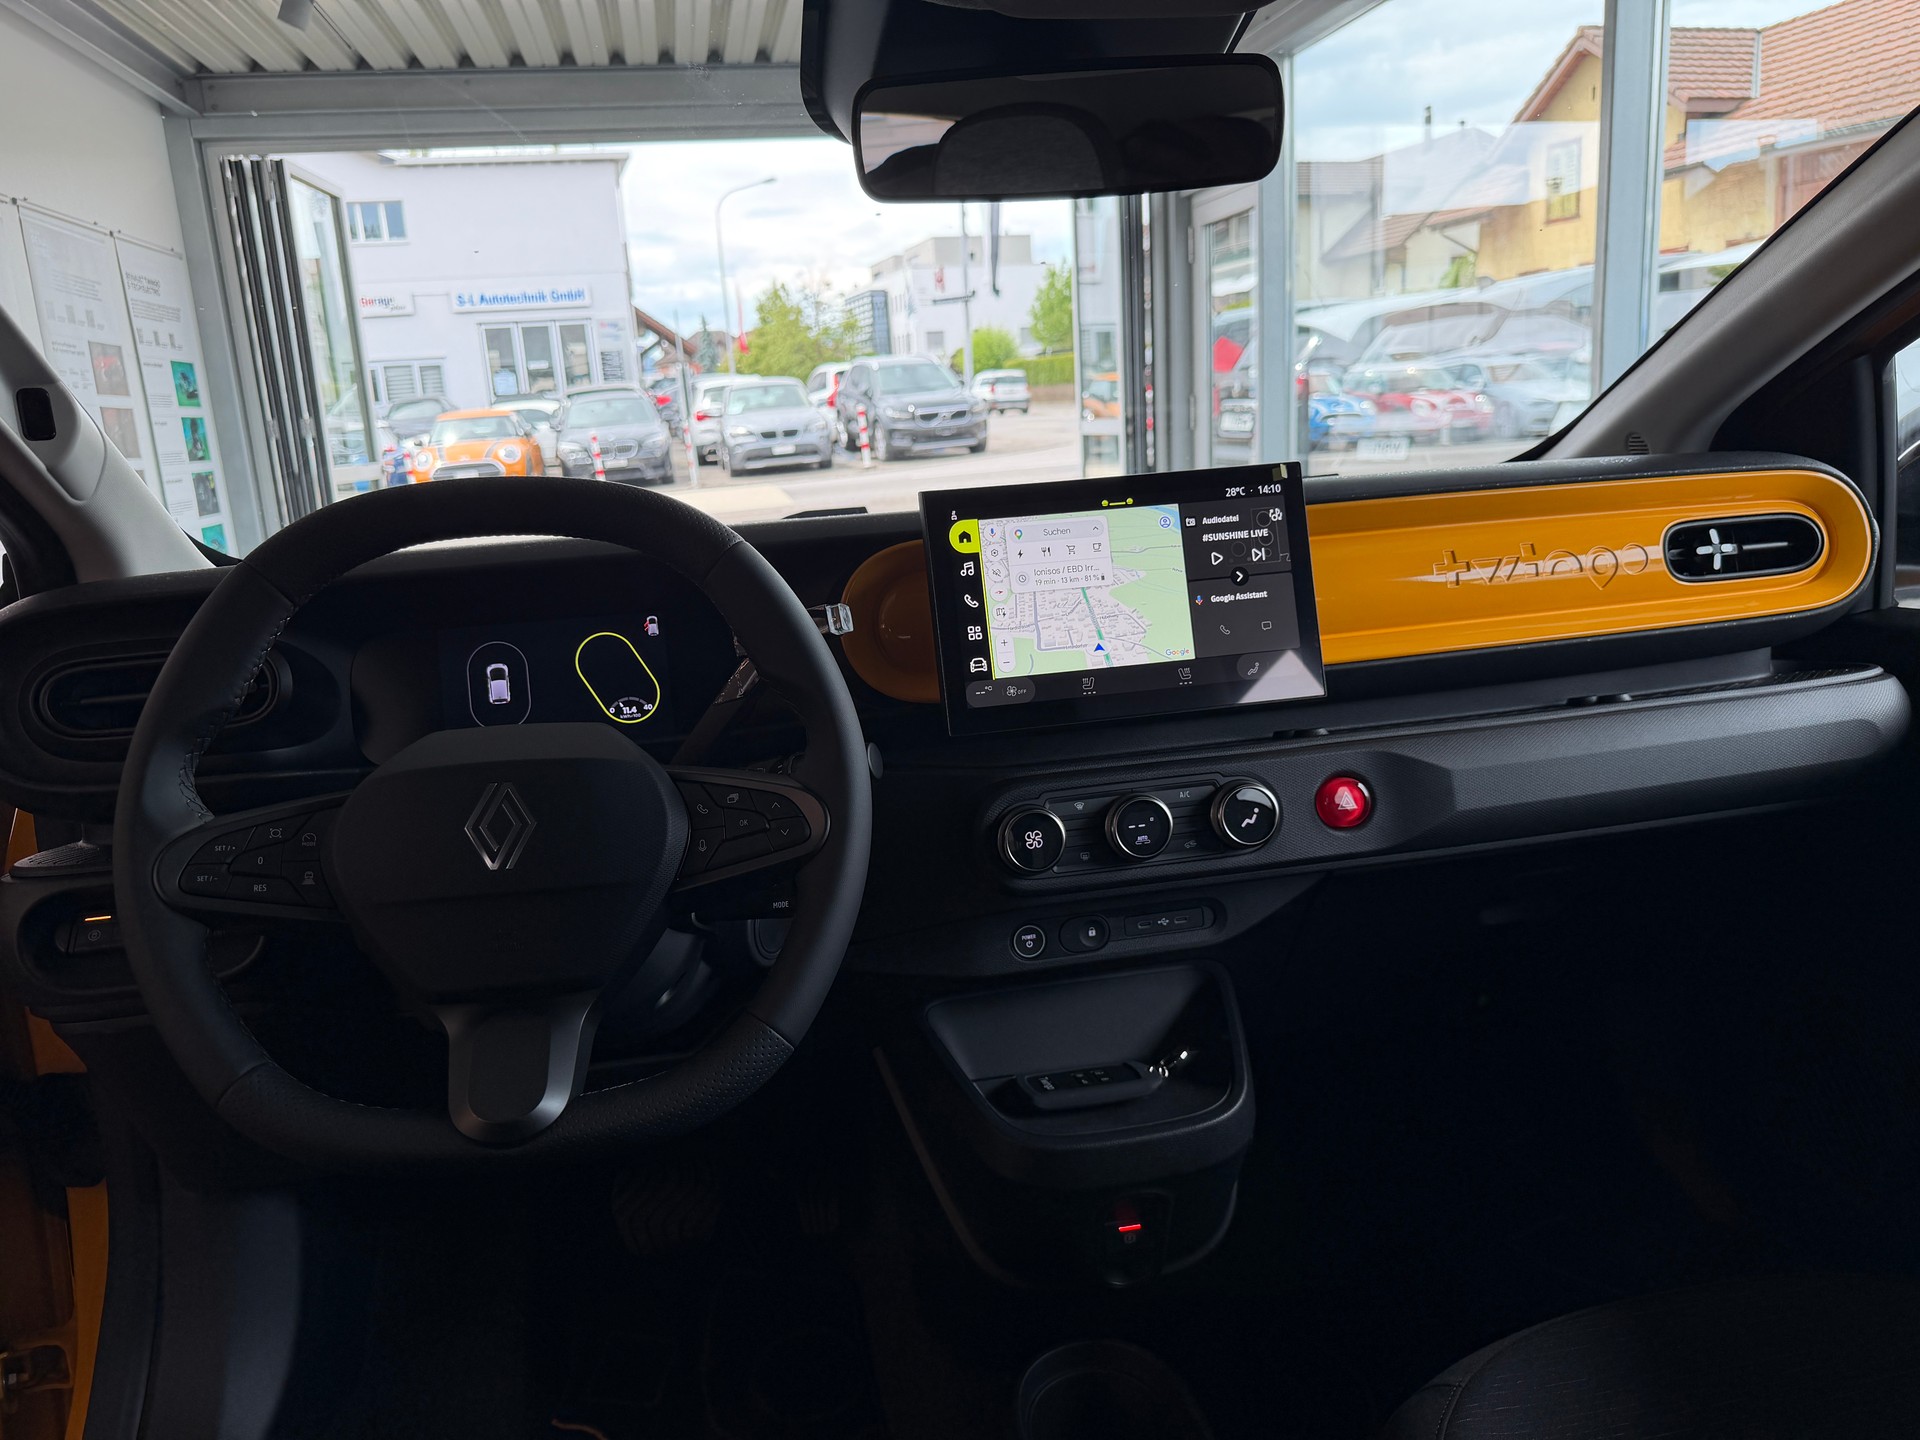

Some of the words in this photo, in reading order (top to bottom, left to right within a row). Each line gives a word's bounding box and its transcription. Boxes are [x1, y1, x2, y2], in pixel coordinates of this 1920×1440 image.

[550, 287, 585, 303] GmbH
[1257, 484, 1282, 495] 14:10
[1202, 514, 1240, 525] Audiodatei
[1043, 527, 1071, 537] Suchen
[1202, 530, 1249, 542] #SUNSHINE
[1250, 528, 1269, 538] LIVE
[1067, 565, 1084, 574] EBD
[1433, 542, 1649, 591] twingo
[1043, 577, 1056, 585] min
[1061, 576, 1068, 584] 13
[1069, 575, 1080, 583] km
[1084, 574, 1092, 582] 81
[1210, 594, 1235, 603] Google
[1235, 590, 1268, 600] Assistant
[1165, 647, 1190, 656] Google
[643, 703, 653, 711] 40
[1179, 790, 1191, 798] A/C
[739, 819, 749, 827] OK
[257, 856, 264, 865] 0
[253, 884, 267, 893] RES
[772, 900, 790, 909] MODE
